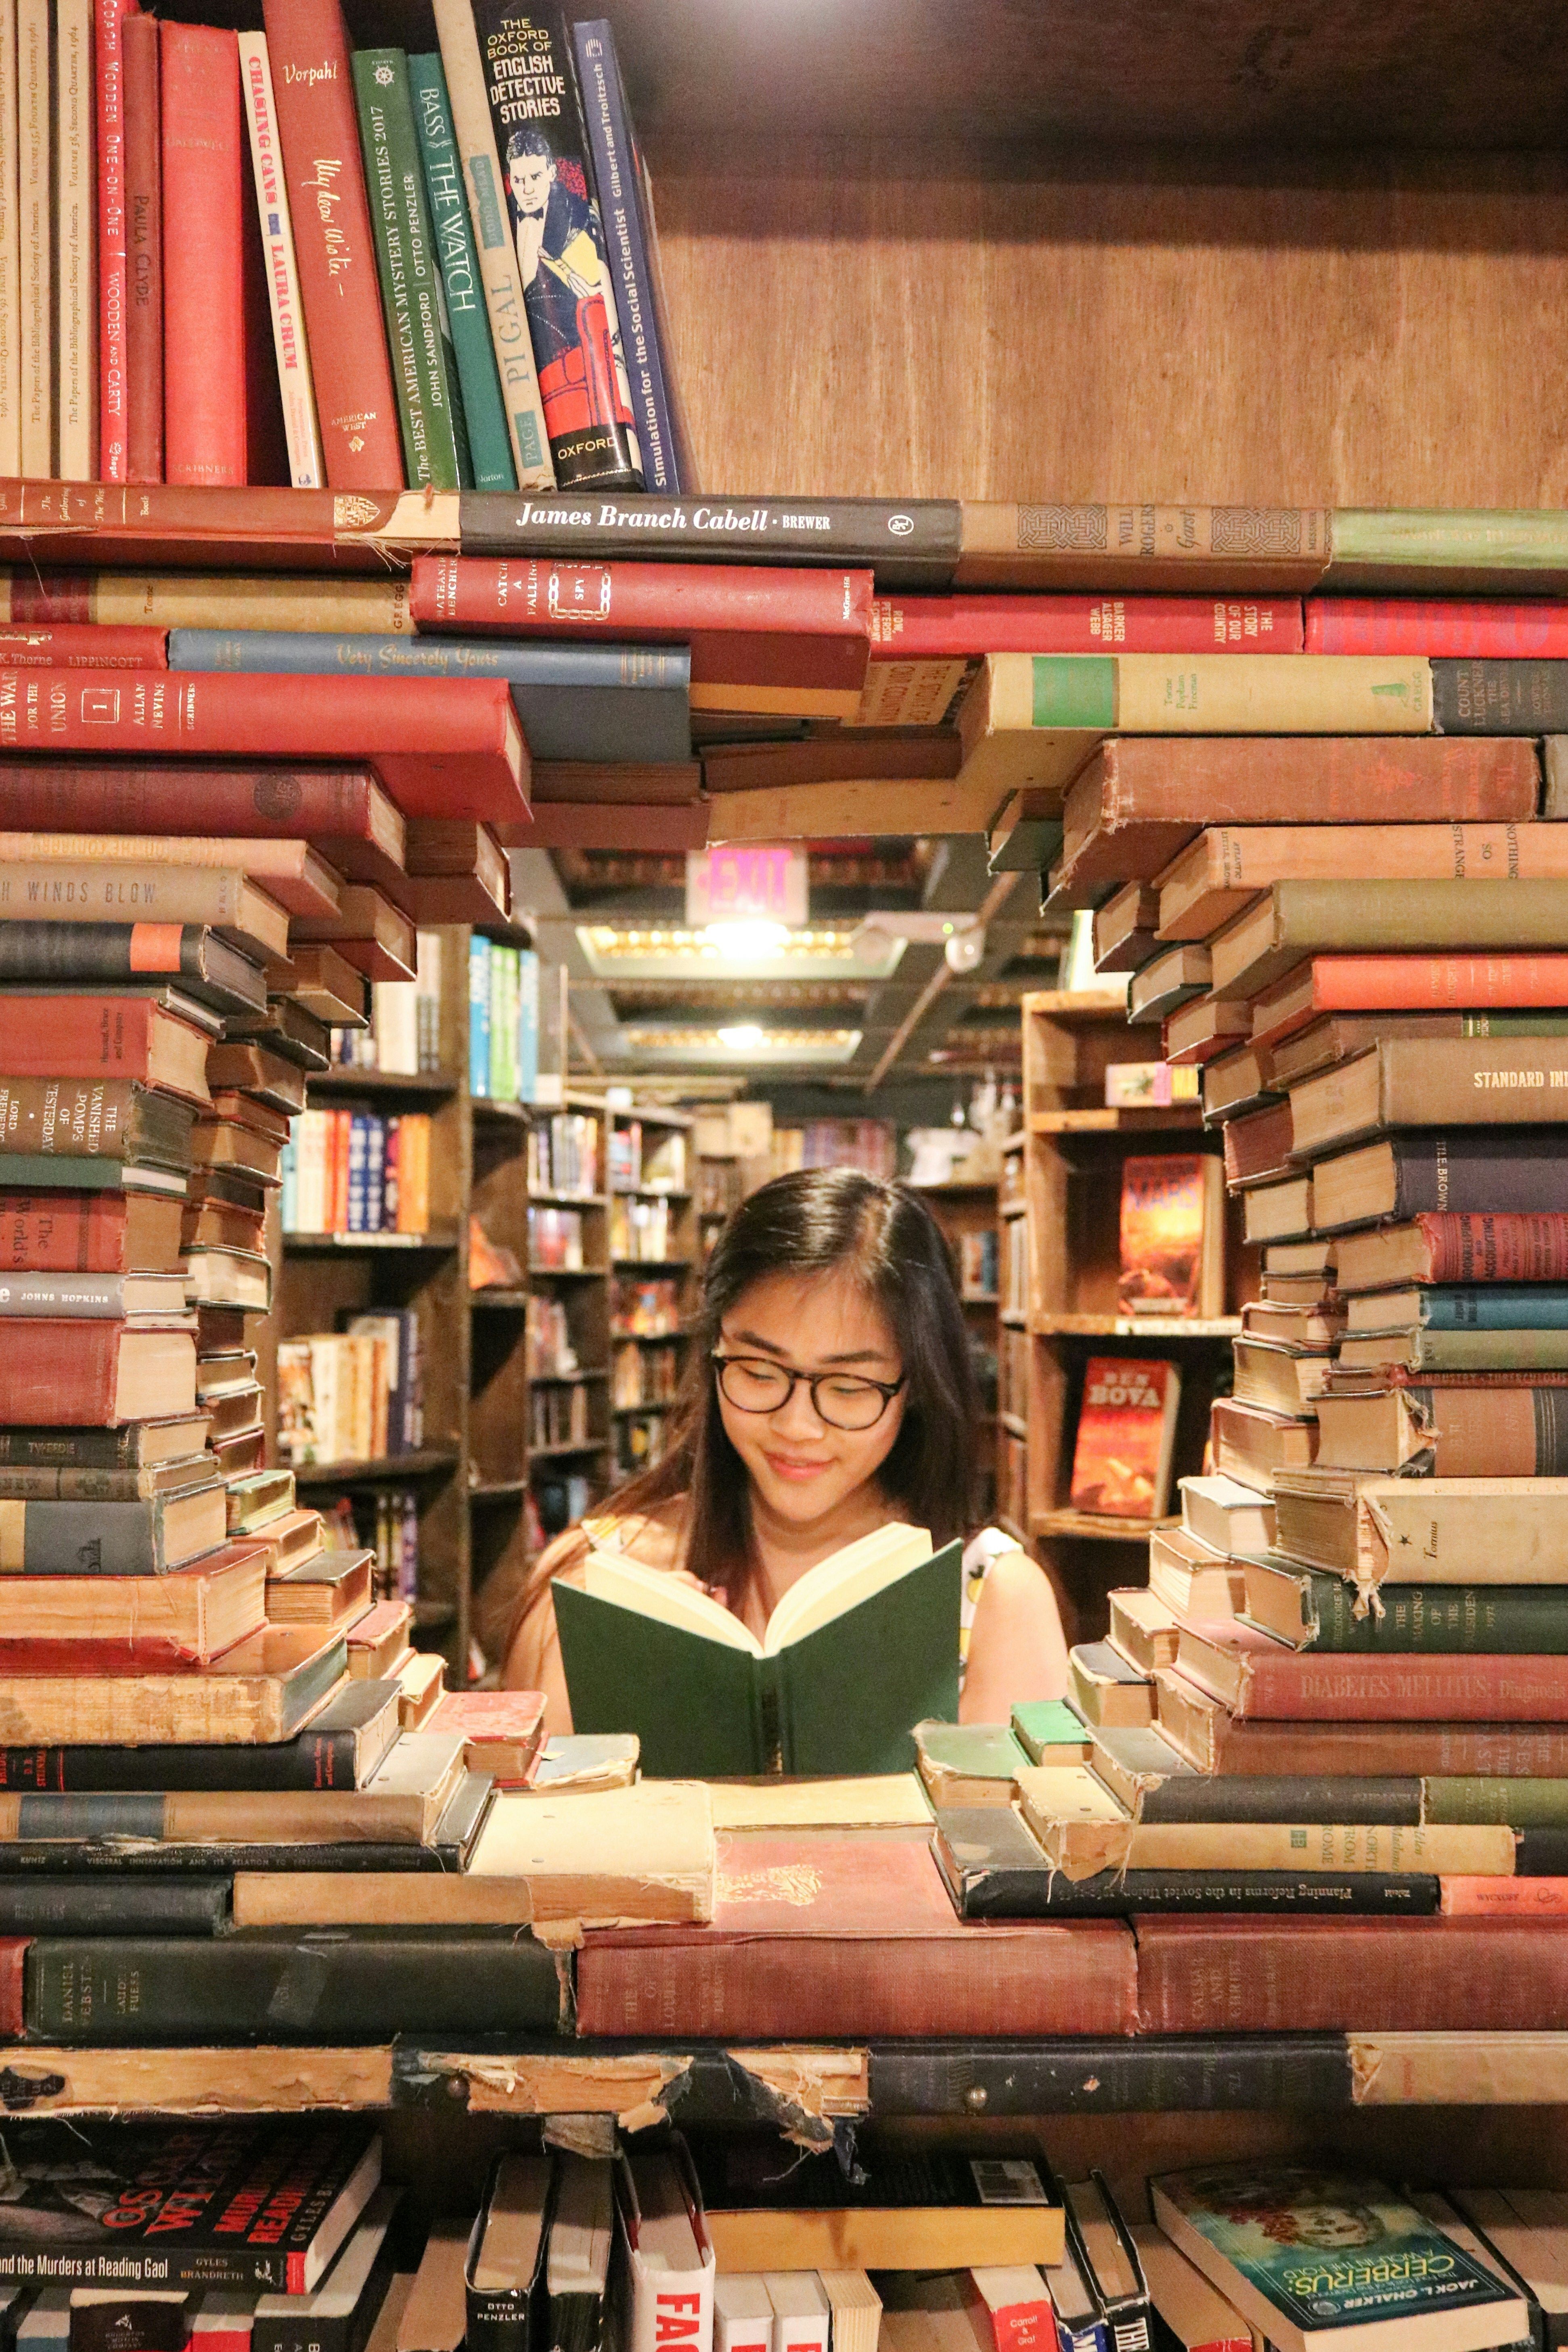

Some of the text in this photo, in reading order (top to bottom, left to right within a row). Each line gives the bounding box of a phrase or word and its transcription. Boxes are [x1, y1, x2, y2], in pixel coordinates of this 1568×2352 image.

[29, 23, 39, 43] 1961
[500, 18, 532, 29] THE
[69, 27, 79, 48] 1964
[487, 29, 549, 46] OXFORD
[487, 41, 553, 59] BOOK OF
[283, 60, 337, 86] Vorpahl
[494, 55, 554, 80] ENGLISH
[490, 76, 566, 106] DETECTIVE
[103, 1, 120, 236] COACH WOODEN ONE-ON-ONE
[500, 97, 561, 124] STORIES
[249, 56, 277, 205] CHASING CANS
[593, 63, 622, 198] Gilbert and Troitzsch
[419, 88, 476, 311] BASS THE WATCH
[30, 201, 39, 239] America.
[30, 240, 39, 250] of
[134, 195, 151, 307] PAULA CLYDE
[30, 252, 41, 281] Society
[370, 106, 430, 481] The BEST AMERICAN MYSTERY STORIES 2017
[404, 175, 443, 408] JOHN SANDFORD OTTO PENZLER
[30, 284, 41, 347] Bibliographical
[69, 203, 80, 425] The Papers of the Bibliographical Society of America.
[271, 244, 298, 370] LAURA CRUM
[108, 272, 121, 416] WOODEN AND CARTY
[614, 207, 668, 487] Simulation for the Social Scientist
[31, 365, 40, 375] of
[31, 376, 42, 403] Papers
[31, 406, 40, 423] The
[331, 412, 377, 425] AMERICAN
[342, 421, 366, 431] WEST
[521, 417, 538, 462] PAIGE
[557, 435, 618, 460] OXFORD
[42, 494, 51, 511] The
[60, 487, 70, 522] Gathering
[141, 495, 149, 517] Booth
[515, 502, 831, 532] James Branch Cabell BREWER
[1118, 510, 1133, 546] WILL
[1140, 504, 1155, 557] ROGERS
[498, 562, 508, 607] CATCH
[513, 581, 522, 590] A
[575, 578, 584, 601] SPY
[842, 576, 850, 620] McGraw-Hill
[394, 583, 404, 628] GREGG
[881, 601, 892, 642] PETERSON
[1090, 608, 1101, 635] WEBB
[1101, 602, 1113, 642] ALSAGER
[1114, 602, 1125, 642] BARKER
[1214, 603, 1226, 644] COUNTRY
[1228, 605, 1242, 641] OF OUR
[1244, 605, 1258, 637] STORY
[1262, 611, 1273, 632] THE
[11, 653, 52, 666] Thorne
[69, 655, 142, 668] LIPPINCOTT
[378, 644, 498, 674] Sincerely Yours
[0, 671, 18, 706] WAR
[27, 682, 38, 703] THE
[1457, 670, 1472, 718] COUNT
[50, 681, 67, 732] UNION
[134, 683, 146, 726] ALLAN
[153, 682, 165, 729] NEVINS
[187, 682, 195, 730] SCRIBNERS
[1482, 843, 1492, 860] SO
[1507, 824, 1519, 879] NOTHING
[29, 882, 156, 904] WINDS BLOW
[1474, 1071, 1544, 1088] STANDARD
[8, 1100, 20, 1130] LORD
[42, 1084, 59, 1153] YESTERDAY
[59, 1108, 70, 1125] OF
[72, 1094, 87, 1142] POMPS
[88, 1085, 104, 1153] VANISHED
[105, 1105, 117, 1132] THE
[13, 1197, 31, 1264] World's
[38, 1215, 53, 1249] The
[21, 1293, 109, 1304] JOHNS HOPKINS
[1090, 1385, 1160, 1408] BOVA
[1395, 1605, 1406, 1630] THE
[1430, 1609, 1442, 1626] OF
[1300, 1675, 1392, 1699] DIABETES
[1164, 1887, 1202, 1900] Soviet
[1205, 1887, 1225, 1899] the
[1229, 1887, 1242, 1899] in
[1245, 1887, 1296, 1899] Reforms
[1299, 1883, 1352, 1902] Planning
[63, 1961, 73, 2023] DANIEL
[17, 2254, 169, 2281] the Murders at Reading Gaol
[180, 2269, 244, 2281] BRANDRETH
[195, 2257, 228, 2269] GYLES
[1287, 2255, 1455, 2296] CERBERUS:
[1344, 2289, 1417, 2309] CHALKER
[1421, 2285, 1433, 2296] L.
[1436, 2279, 1478, 2294] JACK
[477, 2312, 525, 2321] PENZLER
[487, 2303, 515, 2311] OTTO
[1010, 2315, 1038, 2329] Carroll
[1017, 2335, 1036, 2346] Graf
